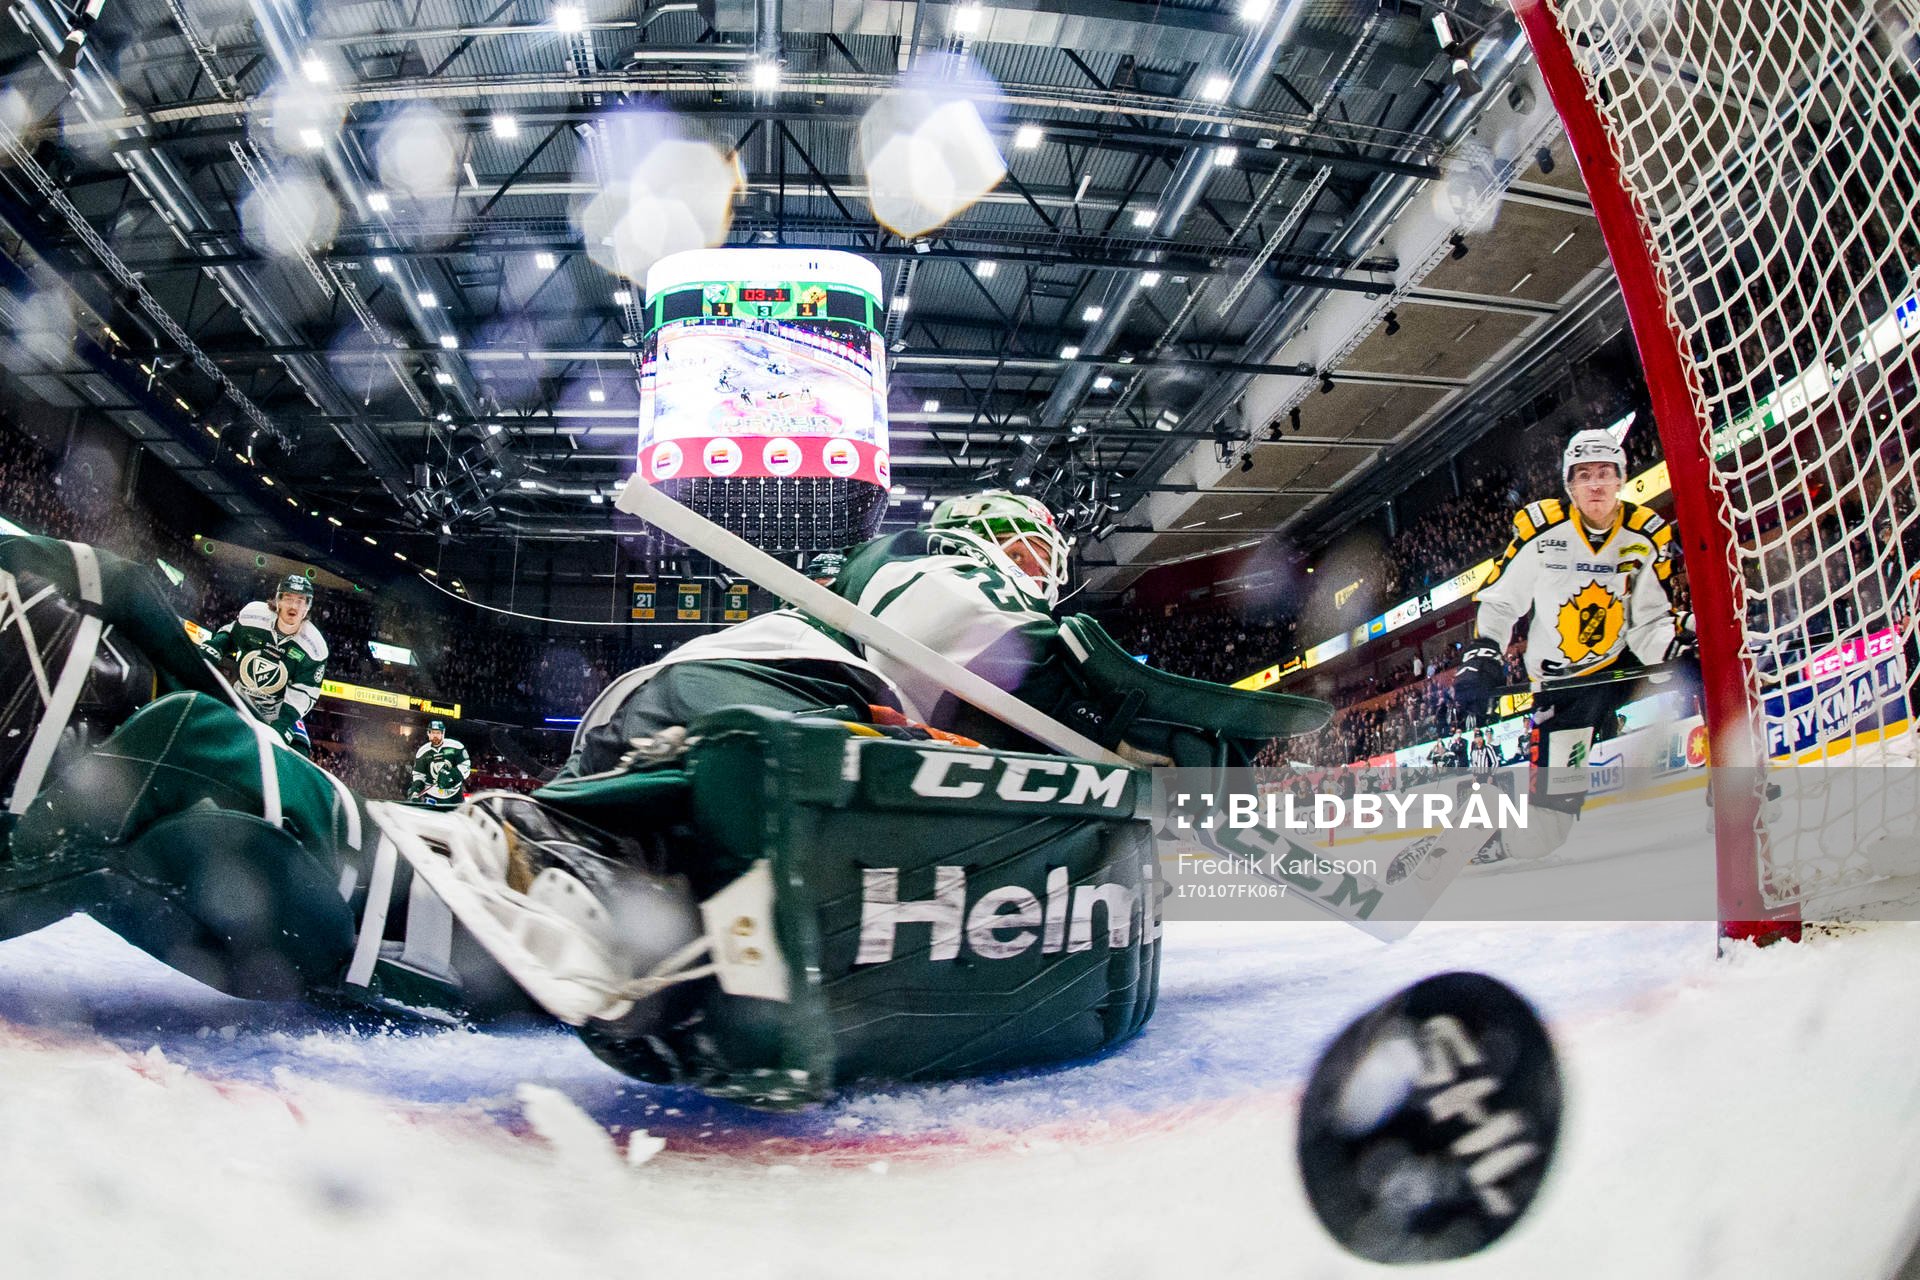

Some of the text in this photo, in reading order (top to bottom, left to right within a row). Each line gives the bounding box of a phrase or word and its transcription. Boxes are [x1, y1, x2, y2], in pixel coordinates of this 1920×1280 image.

[743, 288, 786, 302] 03.1
[717, 303, 728, 316] 1
[759, 306, 770, 317] 3
[802, 303, 813, 316] 1
[1575, 562, 1614, 574] BOLIDEN
[636, 593, 653, 608] 21
[684, 594, 695, 608] 9
[731, 595, 742, 609] 5
[910, 750, 1130, 809] CCM
[1416, 1014, 1537, 1218] SHL
